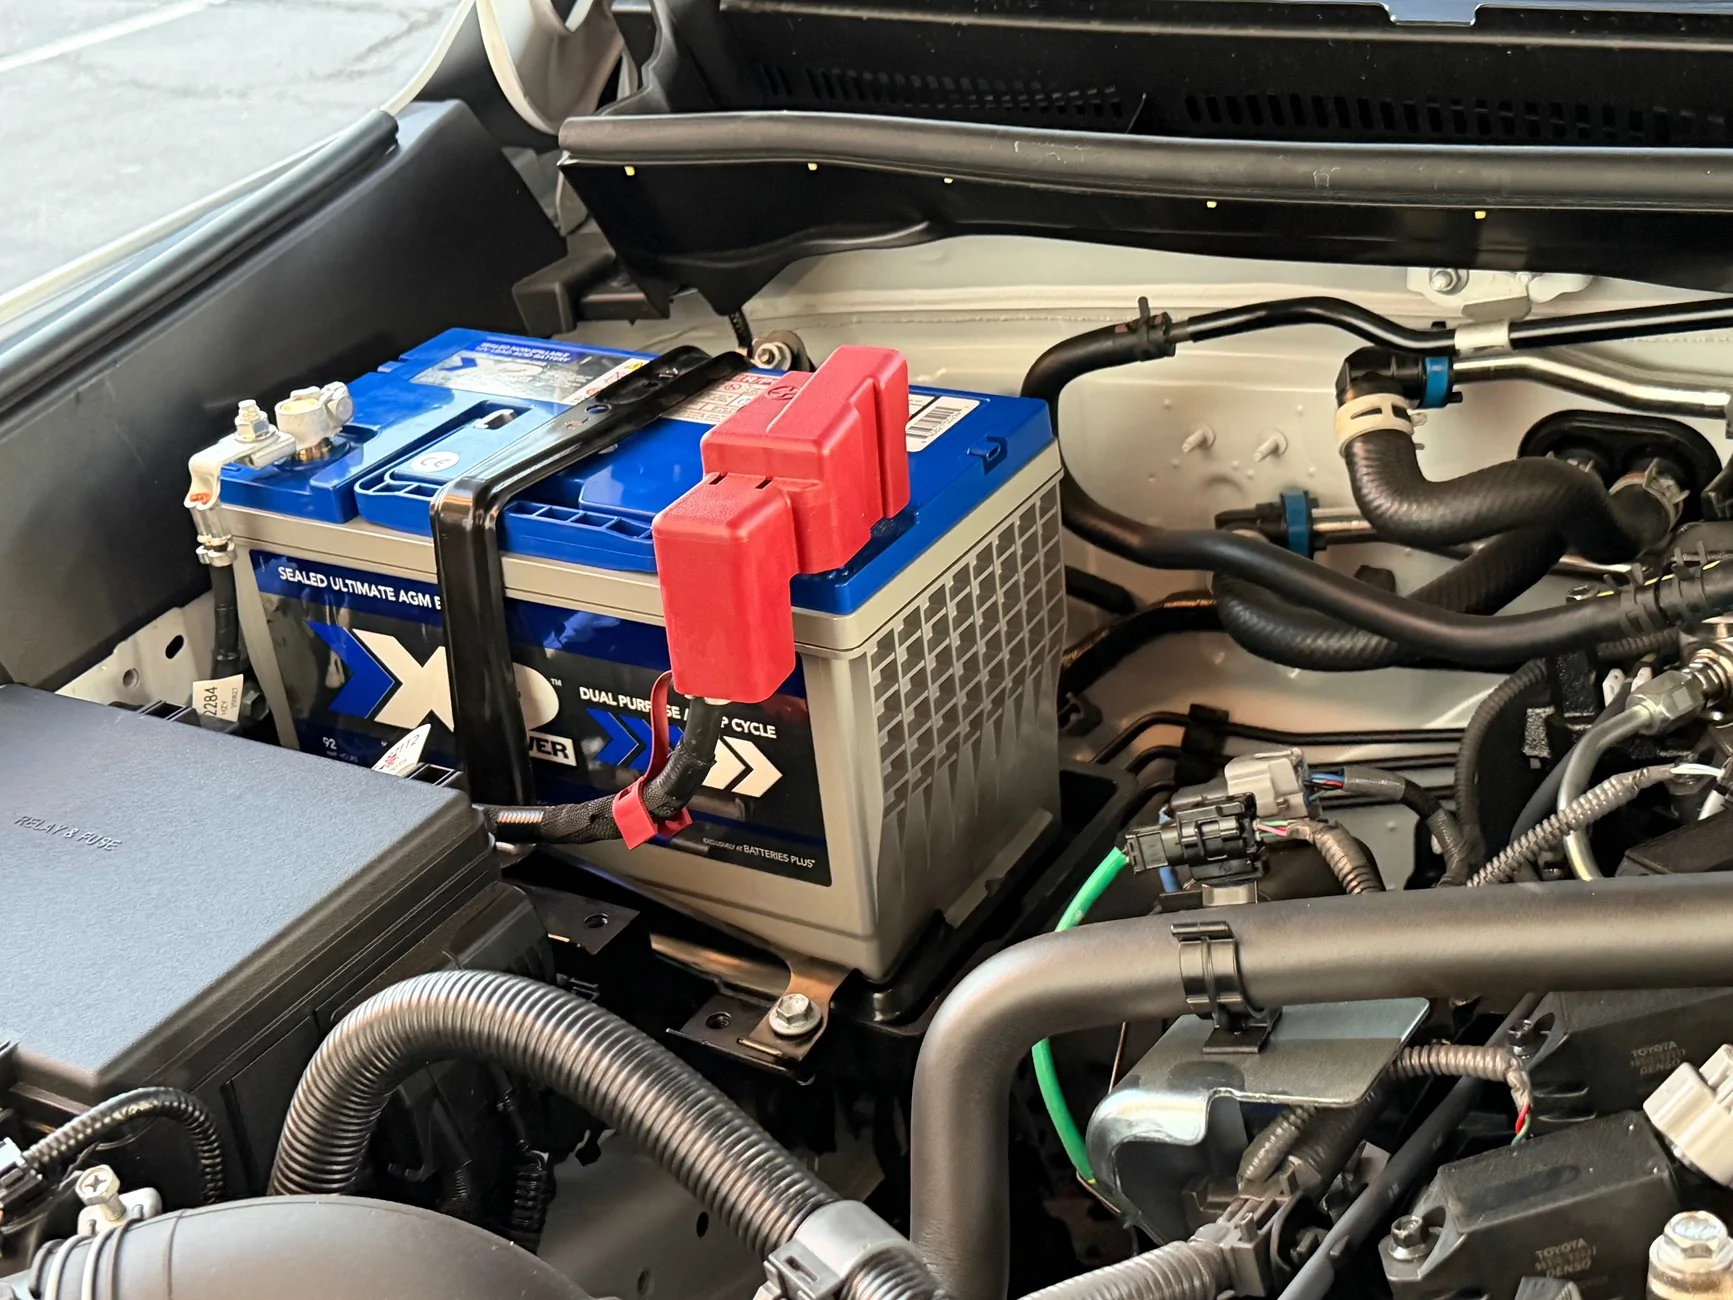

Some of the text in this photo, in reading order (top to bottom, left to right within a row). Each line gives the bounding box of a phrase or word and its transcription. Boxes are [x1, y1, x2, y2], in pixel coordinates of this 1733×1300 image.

[277, 566, 328, 588] SEALED
[330, 576, 396, 602] ULTIMATE
[398, 589, 432, 609] AGM
[579, 686, 618, 706] DUAL
[618, 694, 681, 719] PURPSE
[731, 718, 777, 739] CYCLE
[322, 736, 338, 750] 92
[14, 816, 122, 852] RELAY & FUSE
[743, 844, 789, 863] BATTERIES
[1630, 1041, 1677, 1057] TOYOTA
[1535, 1238, 1587, 1260] TOYOTA
